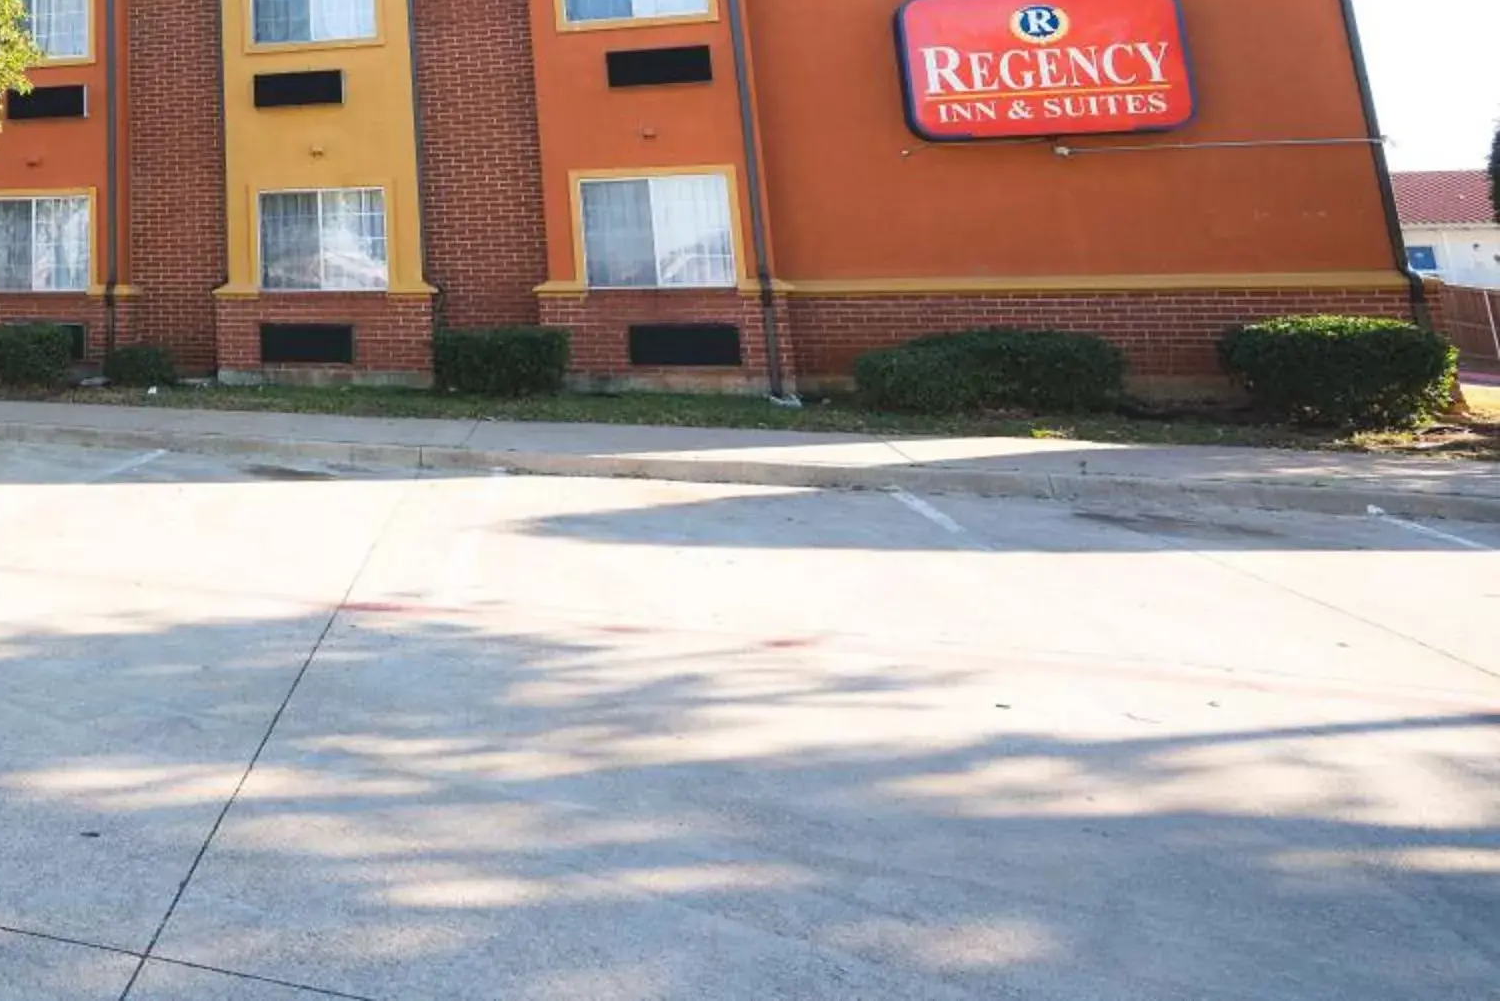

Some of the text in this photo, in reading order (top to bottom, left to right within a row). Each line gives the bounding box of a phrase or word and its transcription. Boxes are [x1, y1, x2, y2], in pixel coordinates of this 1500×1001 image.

[1027, 9, 1054, 35] R
[921, 42, 1169, 94] REGENCY
[938, 93, 1168, 123] INN & SUITES
